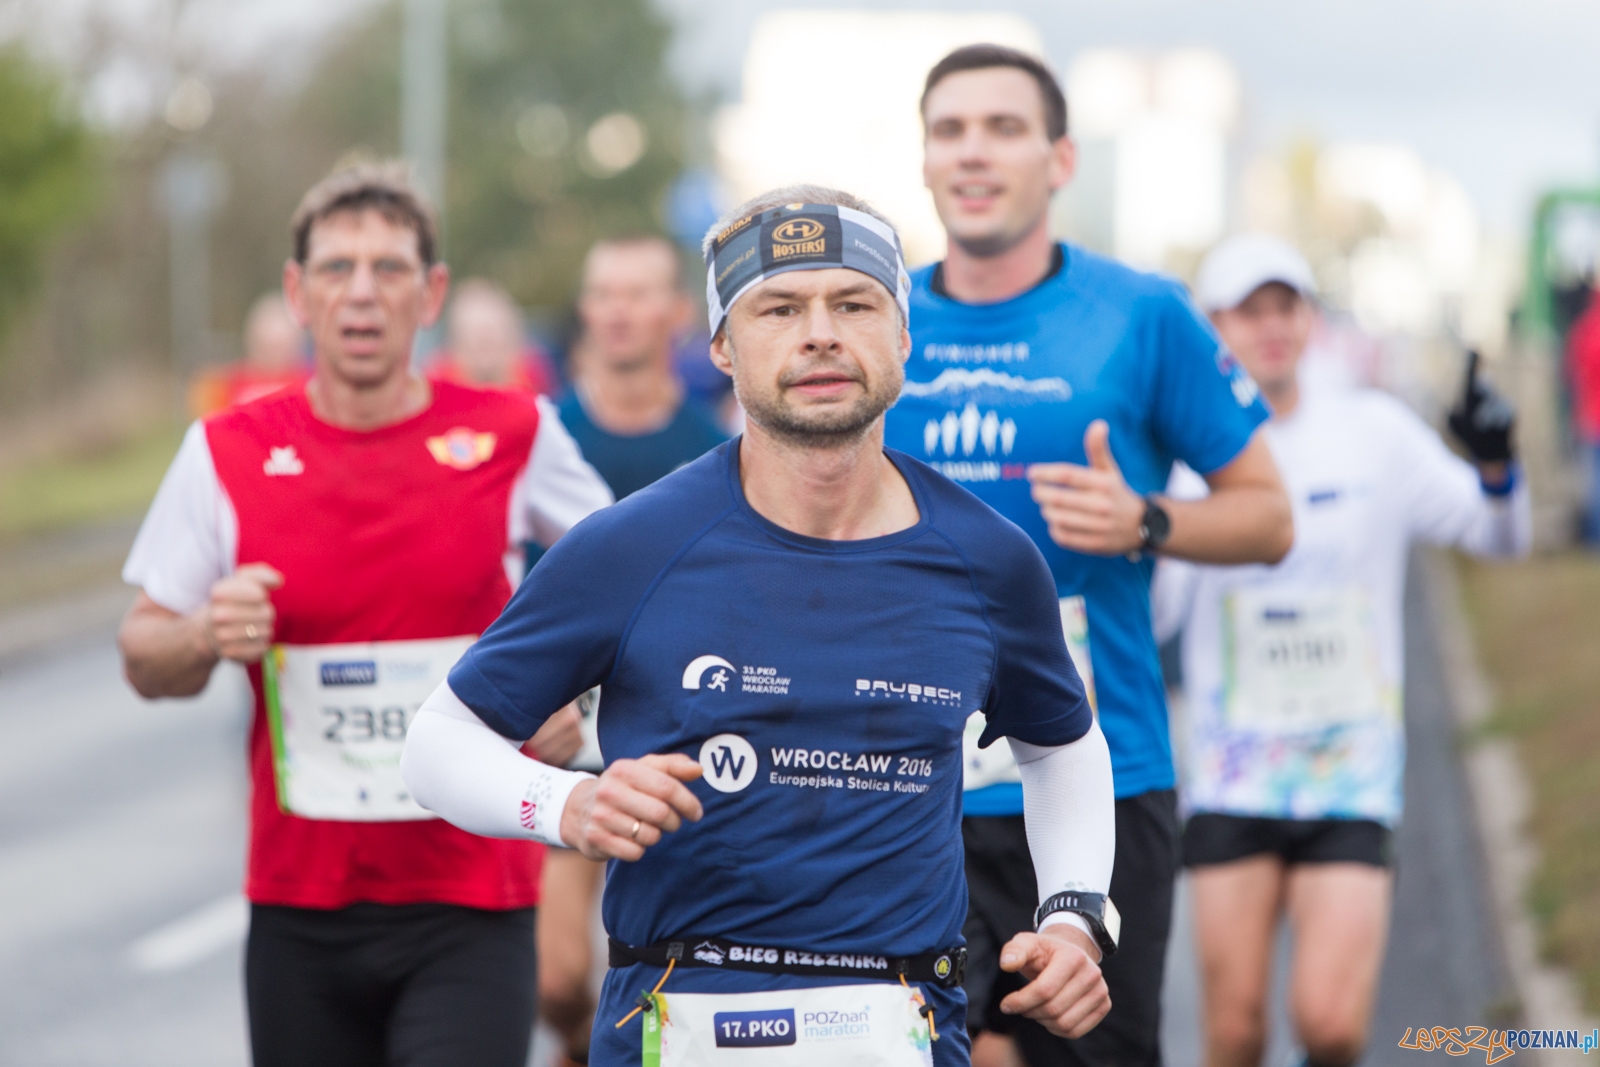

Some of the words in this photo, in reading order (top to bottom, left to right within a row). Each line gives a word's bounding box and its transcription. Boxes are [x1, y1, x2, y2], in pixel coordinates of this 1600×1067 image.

[772, 238, 826, 258] HOSTERSI
[742, 684, 789, 695] MARATON
[855, 678, 962, 701] BRUBECK
[322, 703, 424, 744] 238
[770, 747, 892, 774] WROCŁAW
[897, 757, 933, 778] 2016
[769, 771, 843, 789] Europejska
[847, 776, 890, 792] Stolica
[804, 1023, 870, 1038] maraton
